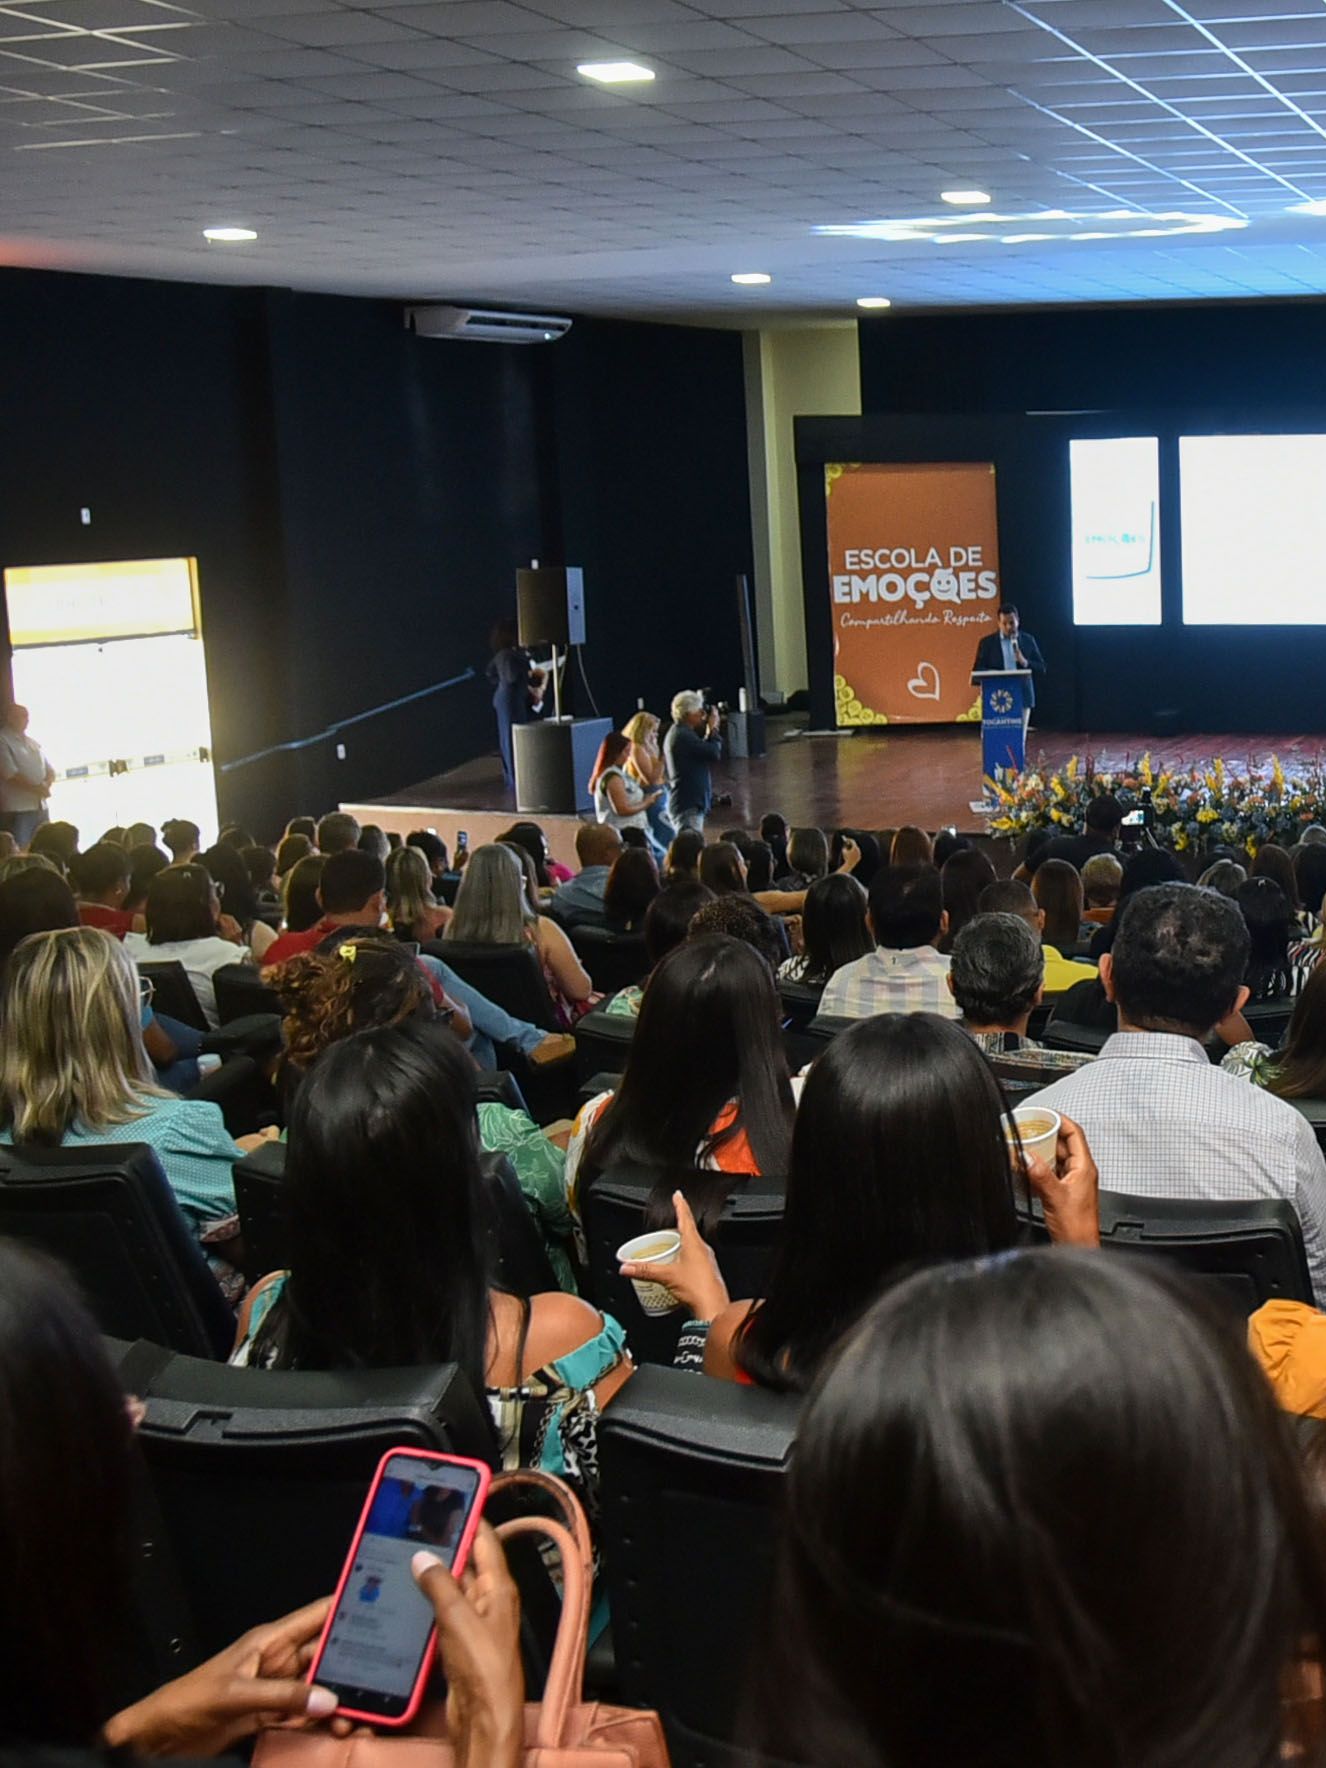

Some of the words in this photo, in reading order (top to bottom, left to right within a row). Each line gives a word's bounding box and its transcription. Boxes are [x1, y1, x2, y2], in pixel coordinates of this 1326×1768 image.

[844, 547, 942, 570] ESCOLA
[950, 546, 983, 568] DE
[832, 567, 997, 609] EMOÇÕES
[840, 609, 940, 628] Compartilhando
[943, 609, 992, 627] Respeito
